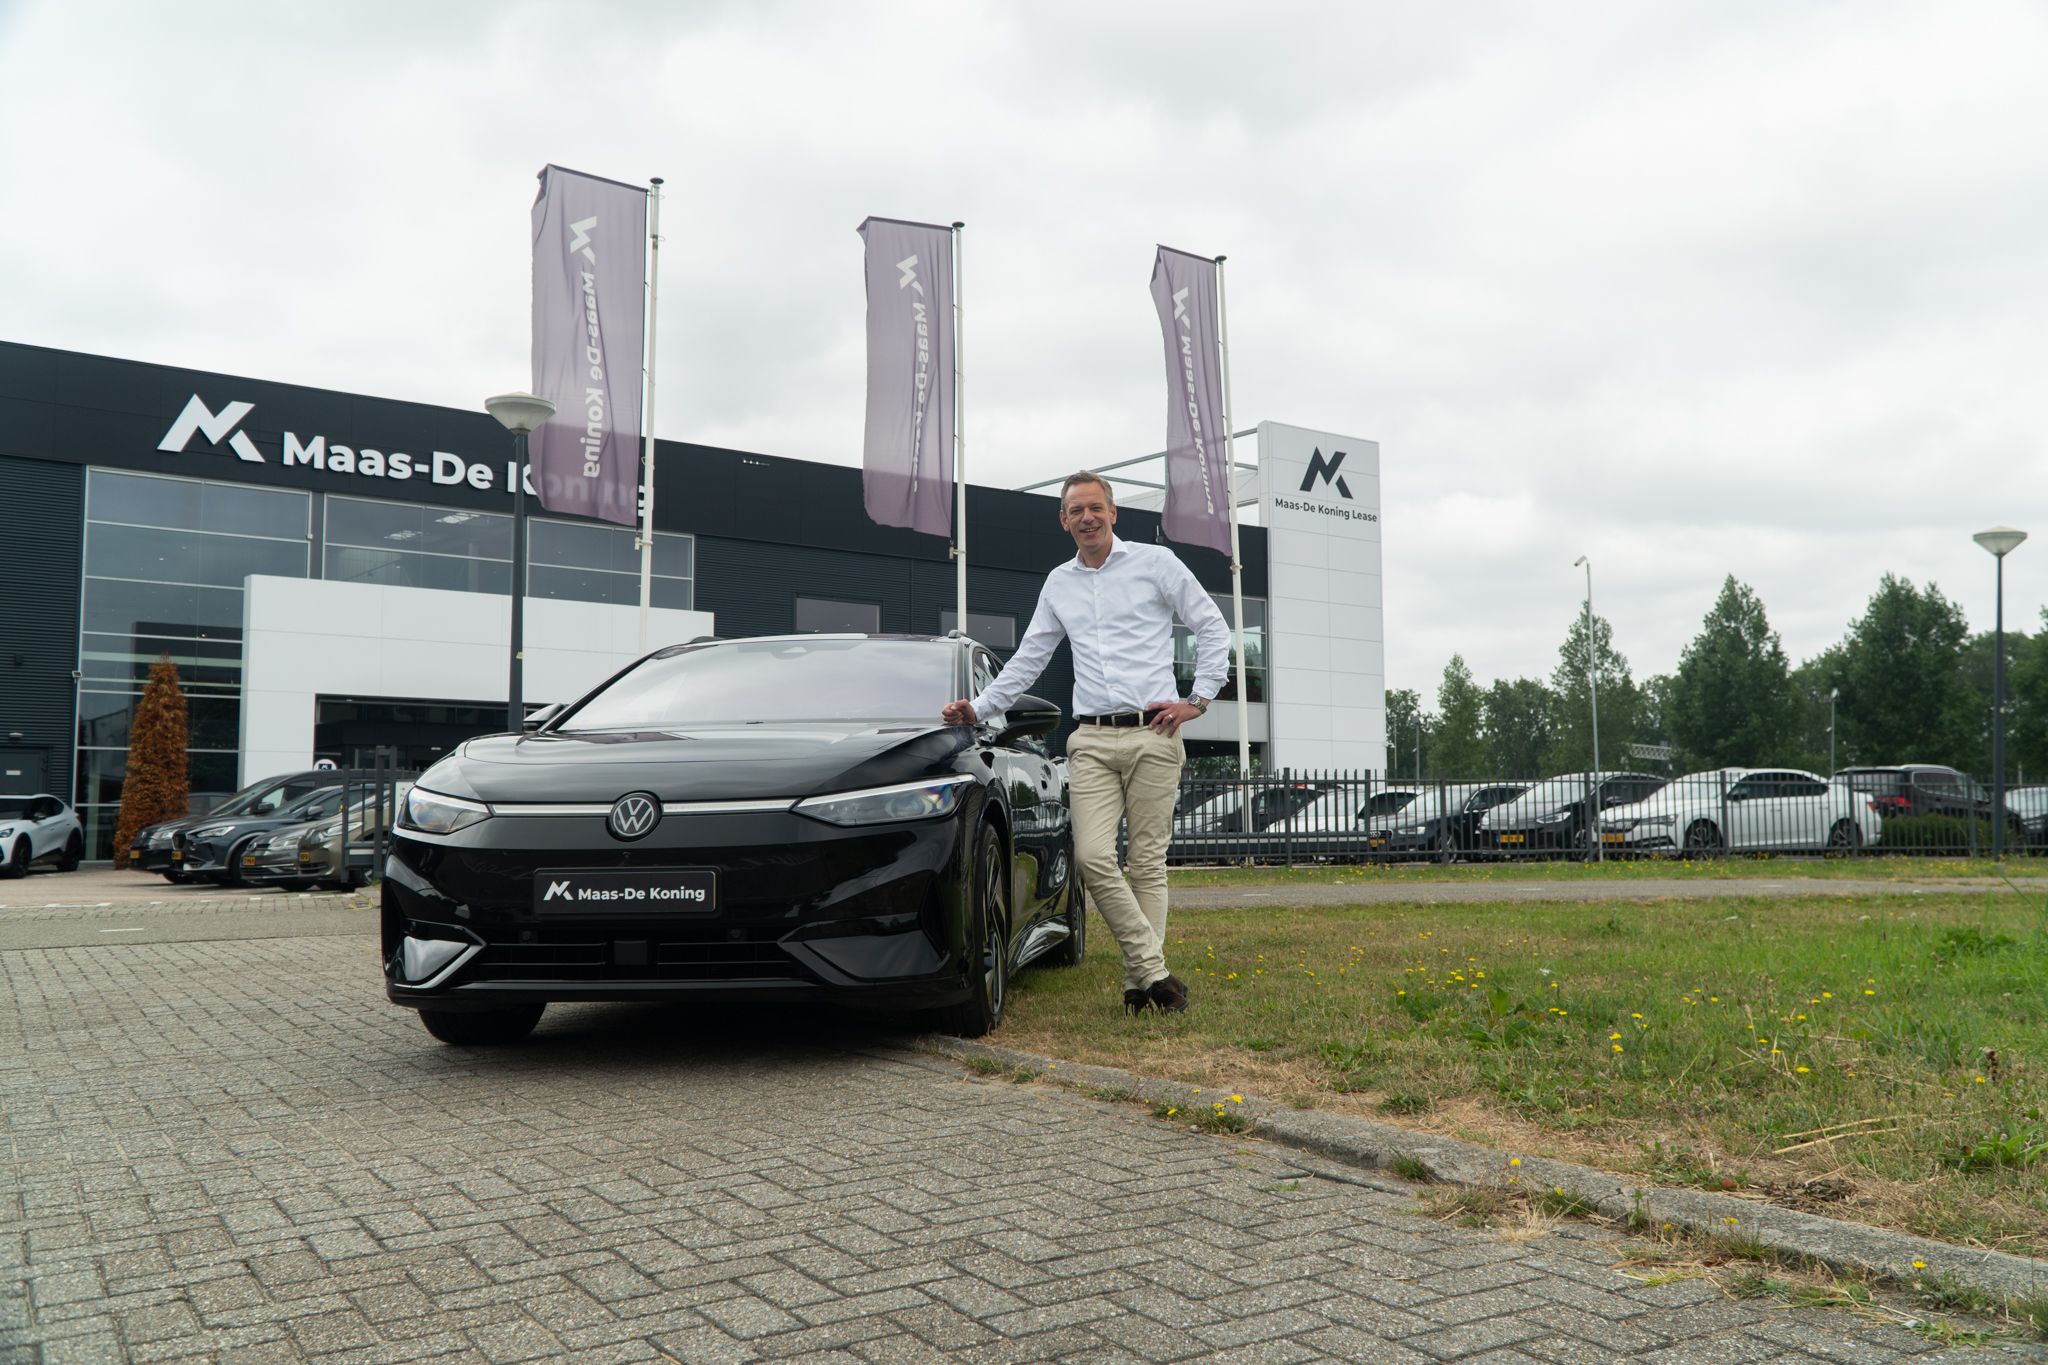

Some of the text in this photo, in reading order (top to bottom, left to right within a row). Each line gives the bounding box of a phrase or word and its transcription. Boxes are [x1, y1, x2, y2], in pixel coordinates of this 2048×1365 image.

[283, 431, 494, 490] Maas-De
[1275, 497, 1378, 523] Maas-De Koning Lease
[578, 887, 646, 901] Maas-De
[649, 885, 706, 902] Koning
